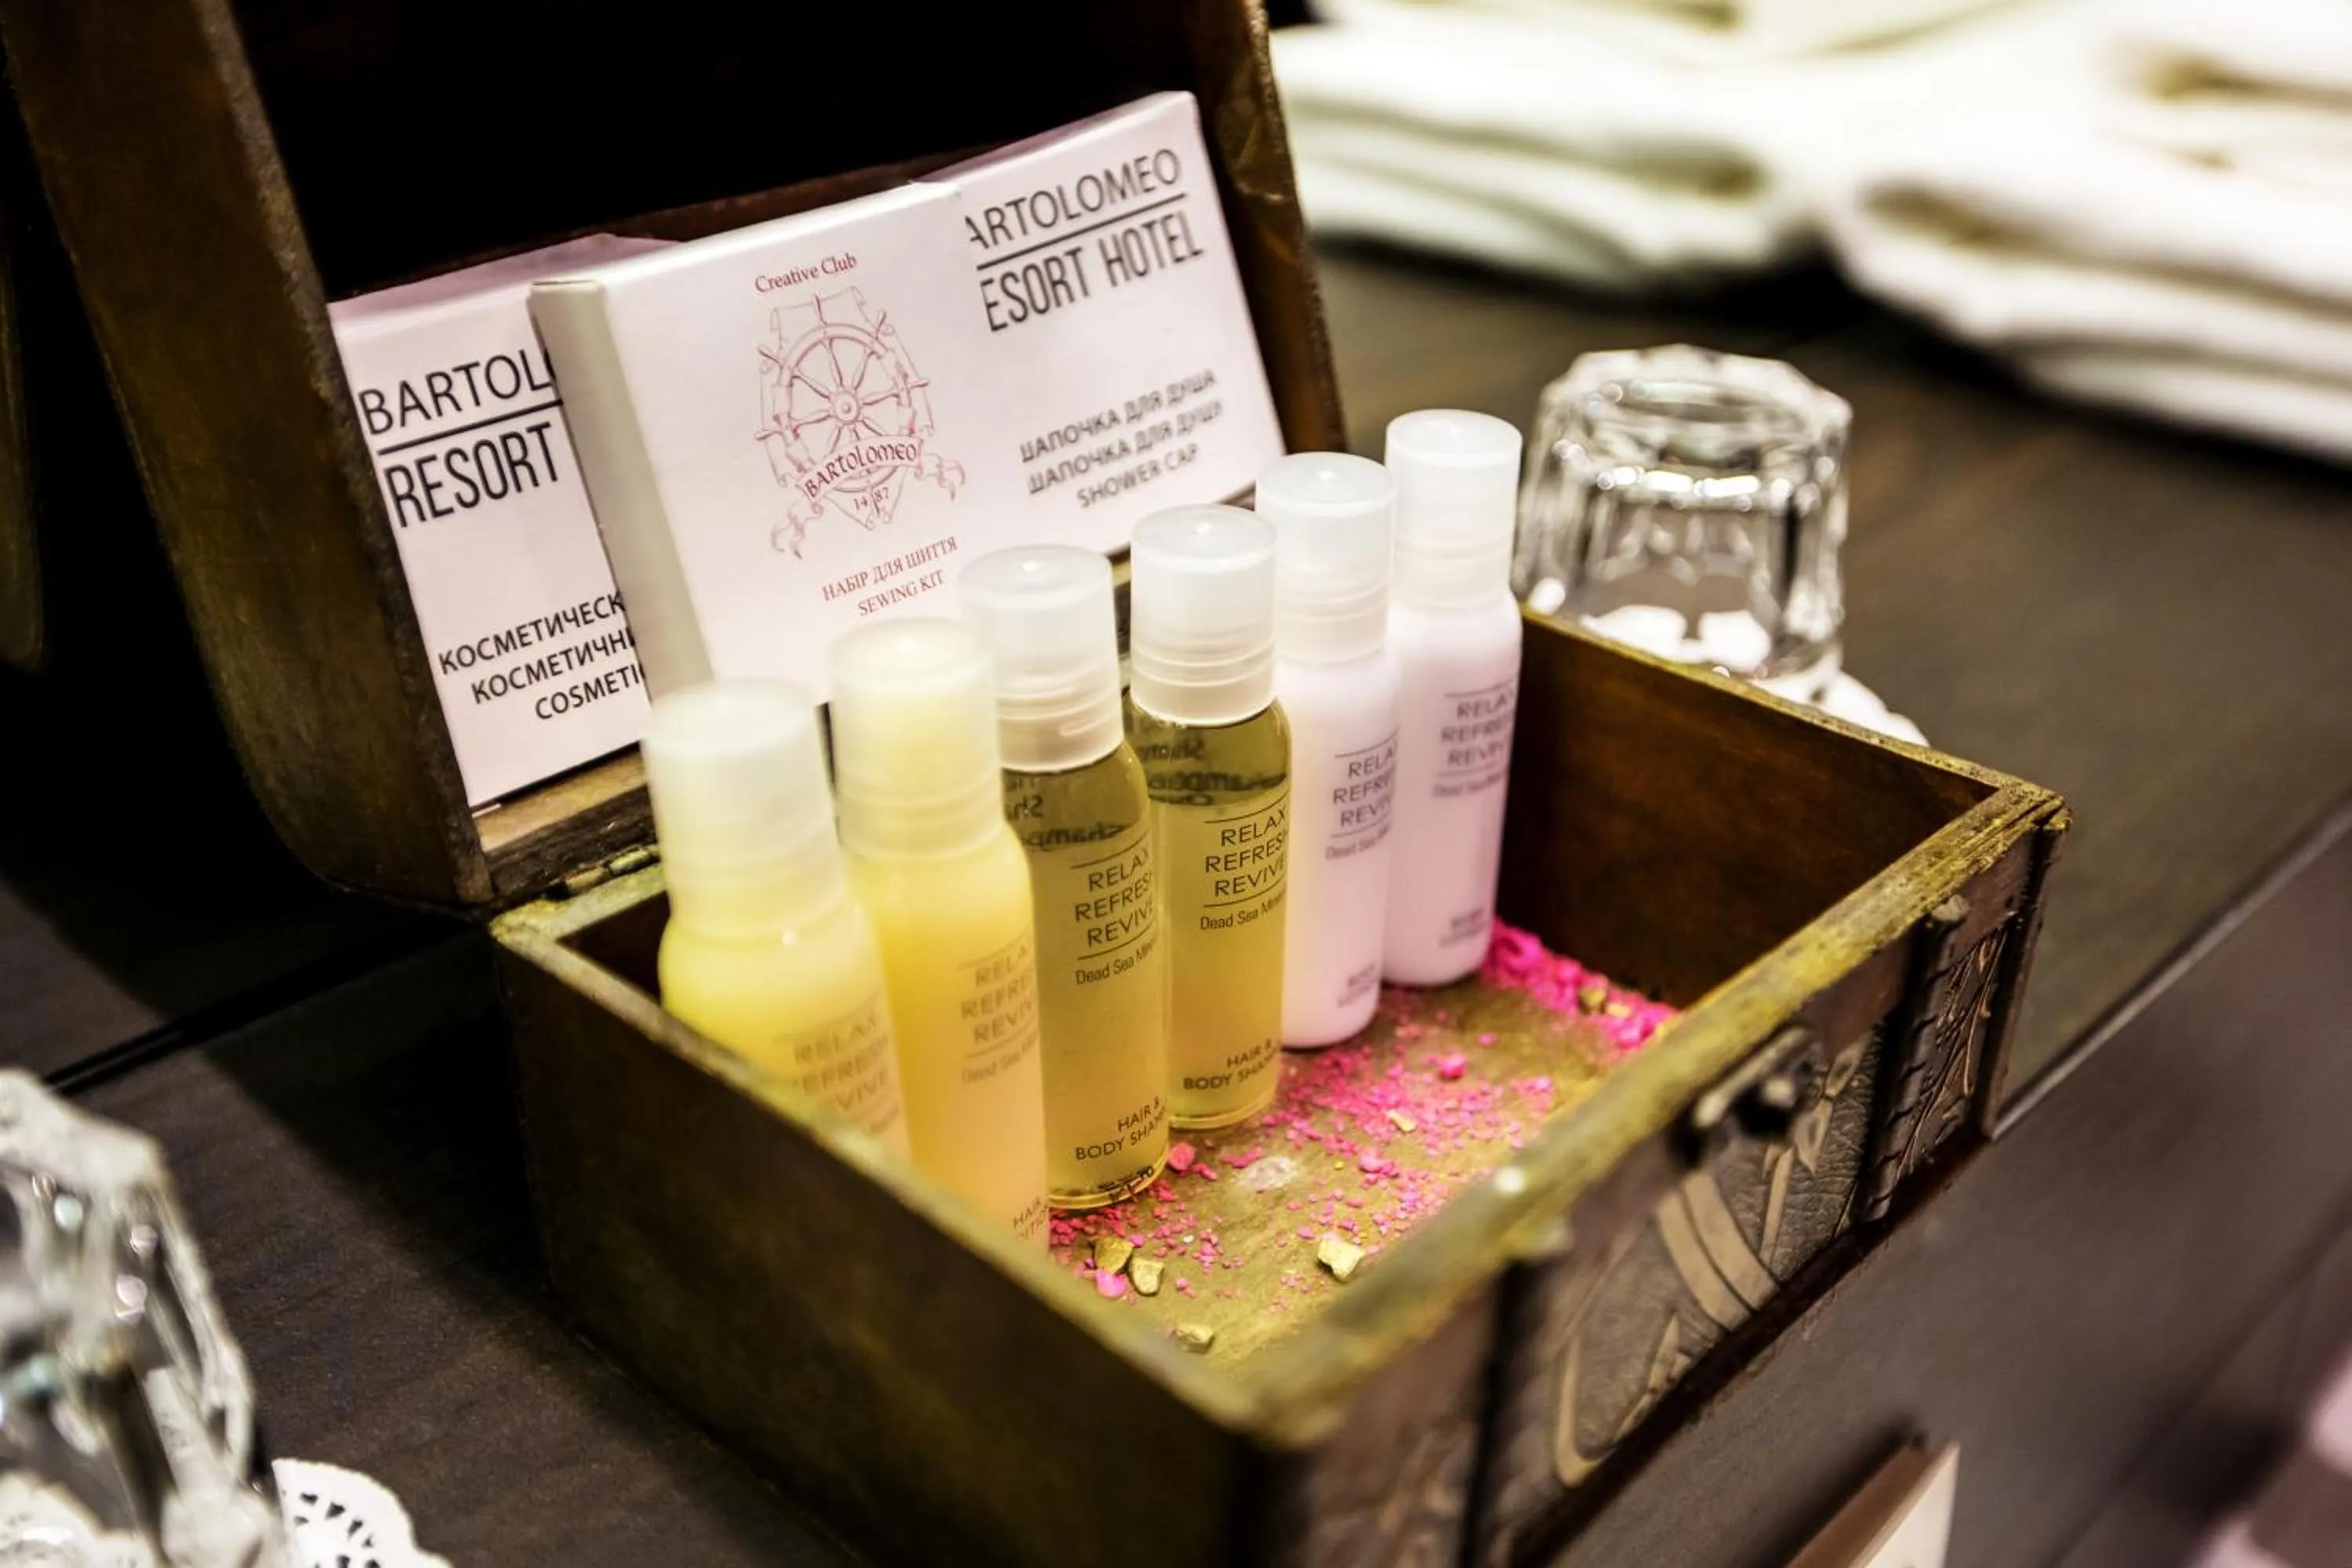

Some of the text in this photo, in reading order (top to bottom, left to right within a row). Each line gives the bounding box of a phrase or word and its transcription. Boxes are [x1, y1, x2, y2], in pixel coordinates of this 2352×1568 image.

[755, 252, 857, 293] Creative Club
[980, 210, 1203, 332] ESORT HOTEL
[358, 349, 555, 436] BARTOL
[1123, 390, 1163, 424] ДЛЯ
[383, 421, 558, 528] RESORT
[1029, 439, 1131, 495] ШАПОЧКА
[1134, 420, 1174, 453] ДЛЯ
[1076, 442, 1200, 509] SHOWER CAP
[822, 535, 958, 601] НАБІР ДЛЯ ШИТТЯ
[858, 569, 945, 616] SEWING KIT
[438, 590, 626, 675] КОСМЕТИЧЕСК
[535, 662, 645, 720] COSMETI
[1348, 743, 1396, 779] RELA
[1221, 804, 1287, 848] RELAX
[1200, 914, 1234, 931] Dead
[1237, 909, 1258, 925] Sea
[975, 944, 1029, 987] RELA
[1075, 963, 1111, 985] Dead
[1112, 957, 1135, 975] Sea
[1183, 1074, 1232, 1091] BODY
[1118, 1105, 1152, 1132] HAIR
[1075, 1137, 1124, 1160] BODY
